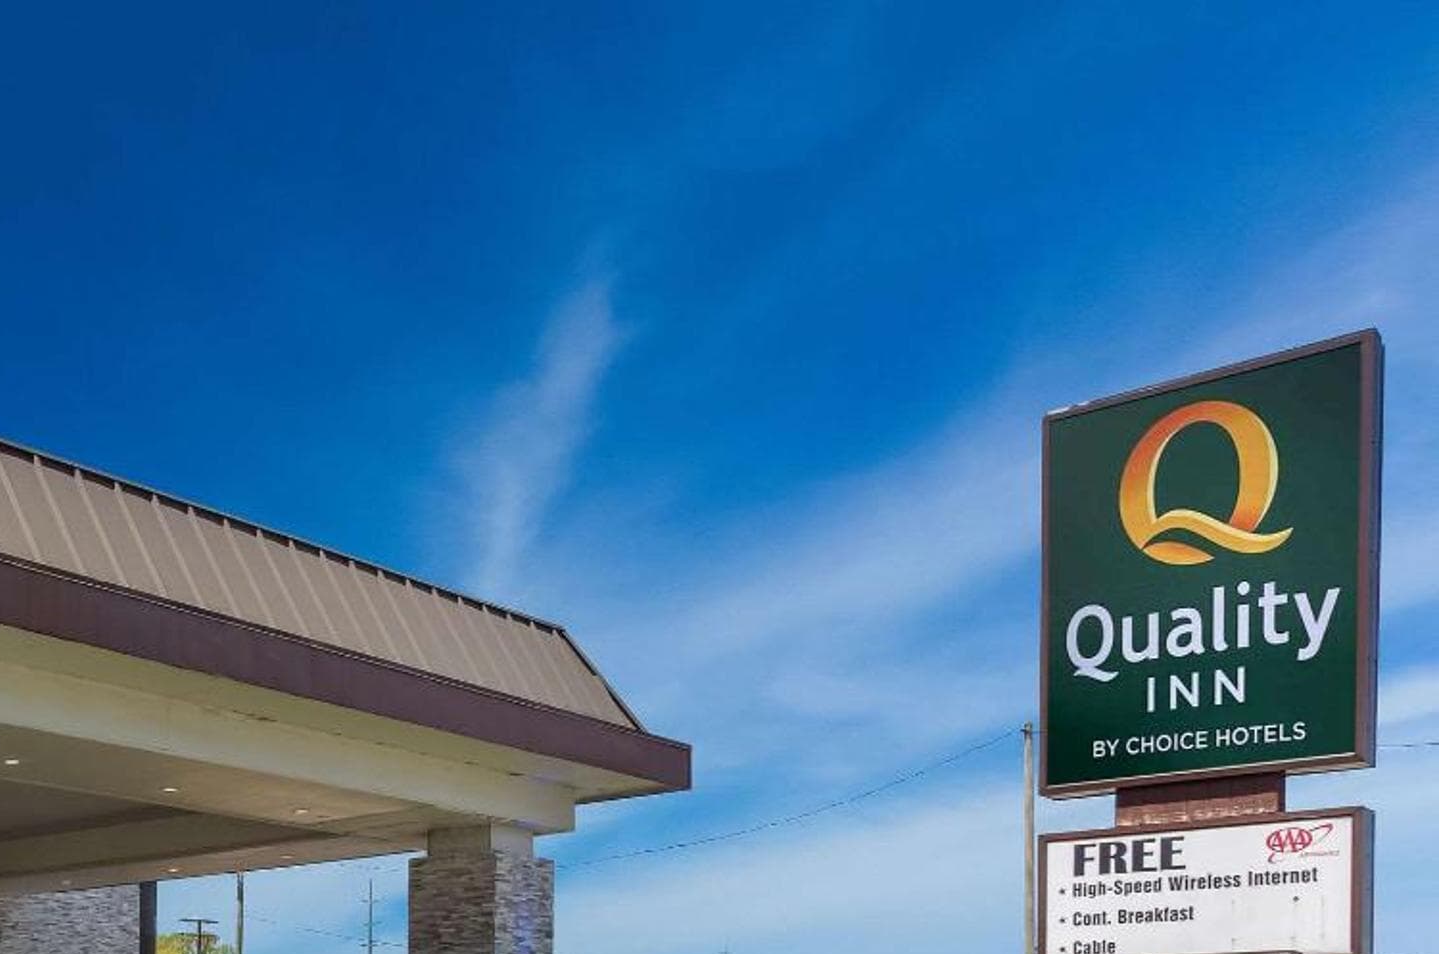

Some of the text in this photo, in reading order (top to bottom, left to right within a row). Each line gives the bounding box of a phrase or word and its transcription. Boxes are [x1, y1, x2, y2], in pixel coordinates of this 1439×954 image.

[1066, 581, 1341, 682] Quality
[1146, 666, 1247, 713] INN
[1092, 722, 1306, 758] BY CHOICE HOTELS
[1073, 836, 1186, 877] FREE
[1270, 828, 1312, 853] AAA
[1072, 867, 1318, 899] High-Speed Wireless Internet
[1072, 906, 1195, 927] Cont. Breakfast
